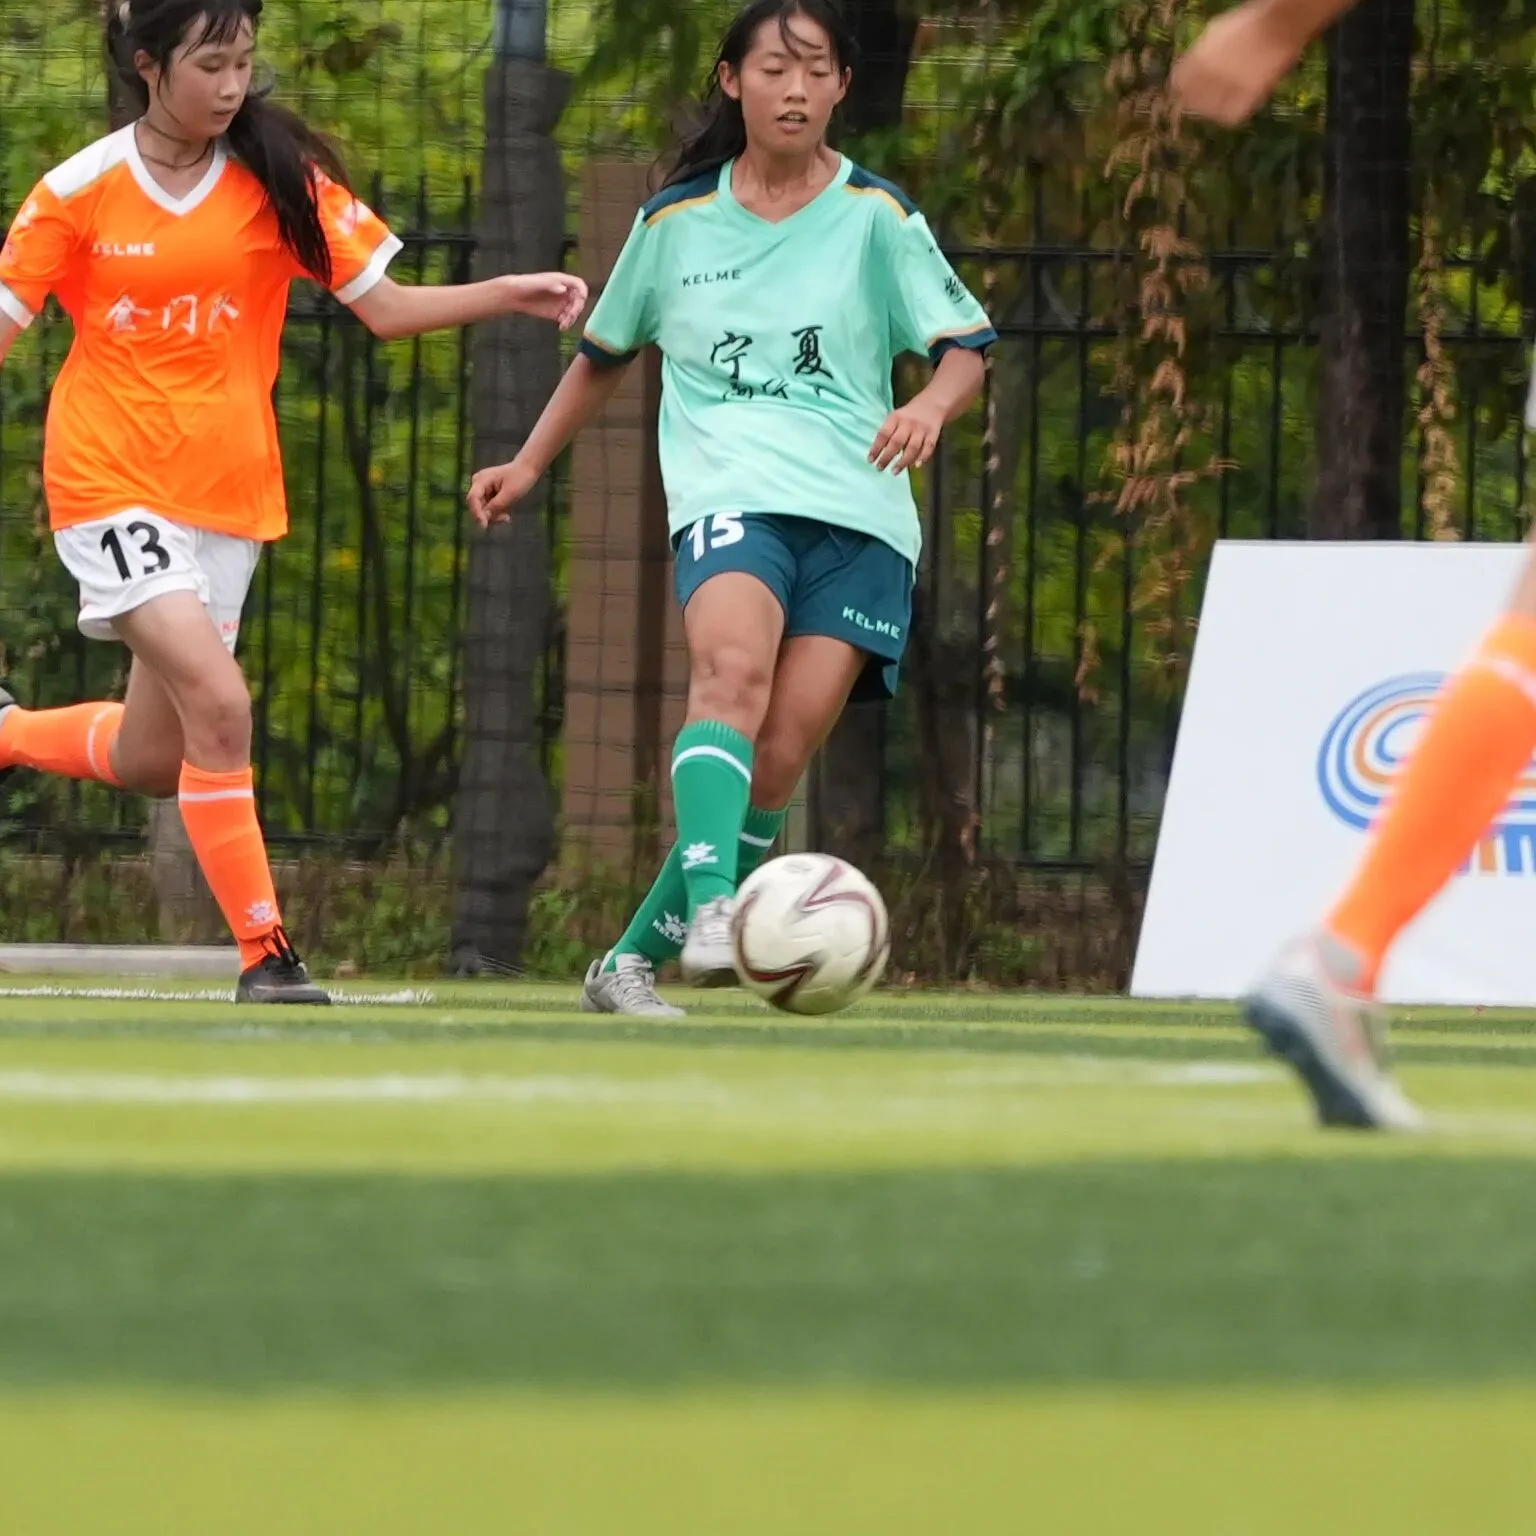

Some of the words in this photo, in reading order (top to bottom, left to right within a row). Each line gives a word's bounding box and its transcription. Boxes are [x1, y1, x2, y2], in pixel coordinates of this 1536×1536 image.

[681, 268, 743, 288] KELME
[710, 325, 834, 380] 宁夏
[100, 521, 171, 583] 13
[687, 511, 745, 563] 15
[842, 605, 901, 641] KELME
